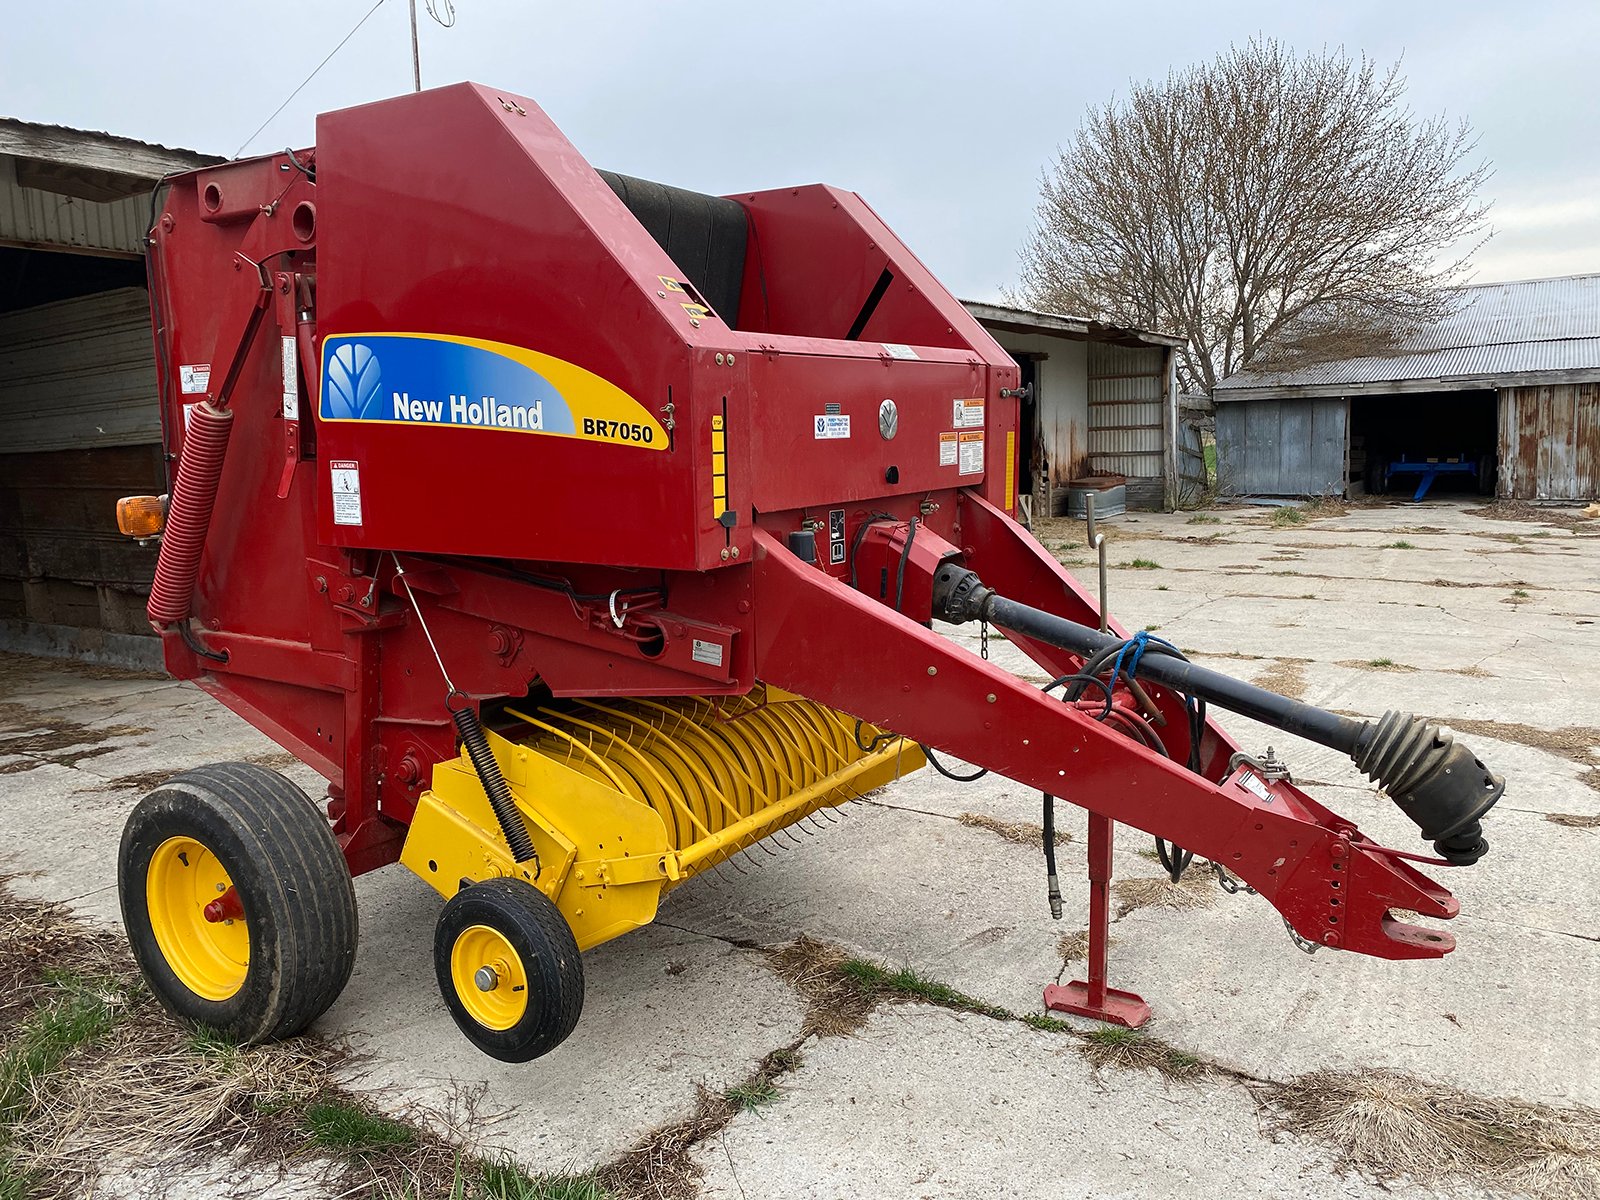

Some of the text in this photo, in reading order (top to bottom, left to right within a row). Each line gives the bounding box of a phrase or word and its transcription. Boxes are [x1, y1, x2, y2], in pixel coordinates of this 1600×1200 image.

[393, 392, 543, 430] New Holland
[583, 418, 654, 444] BR7050
